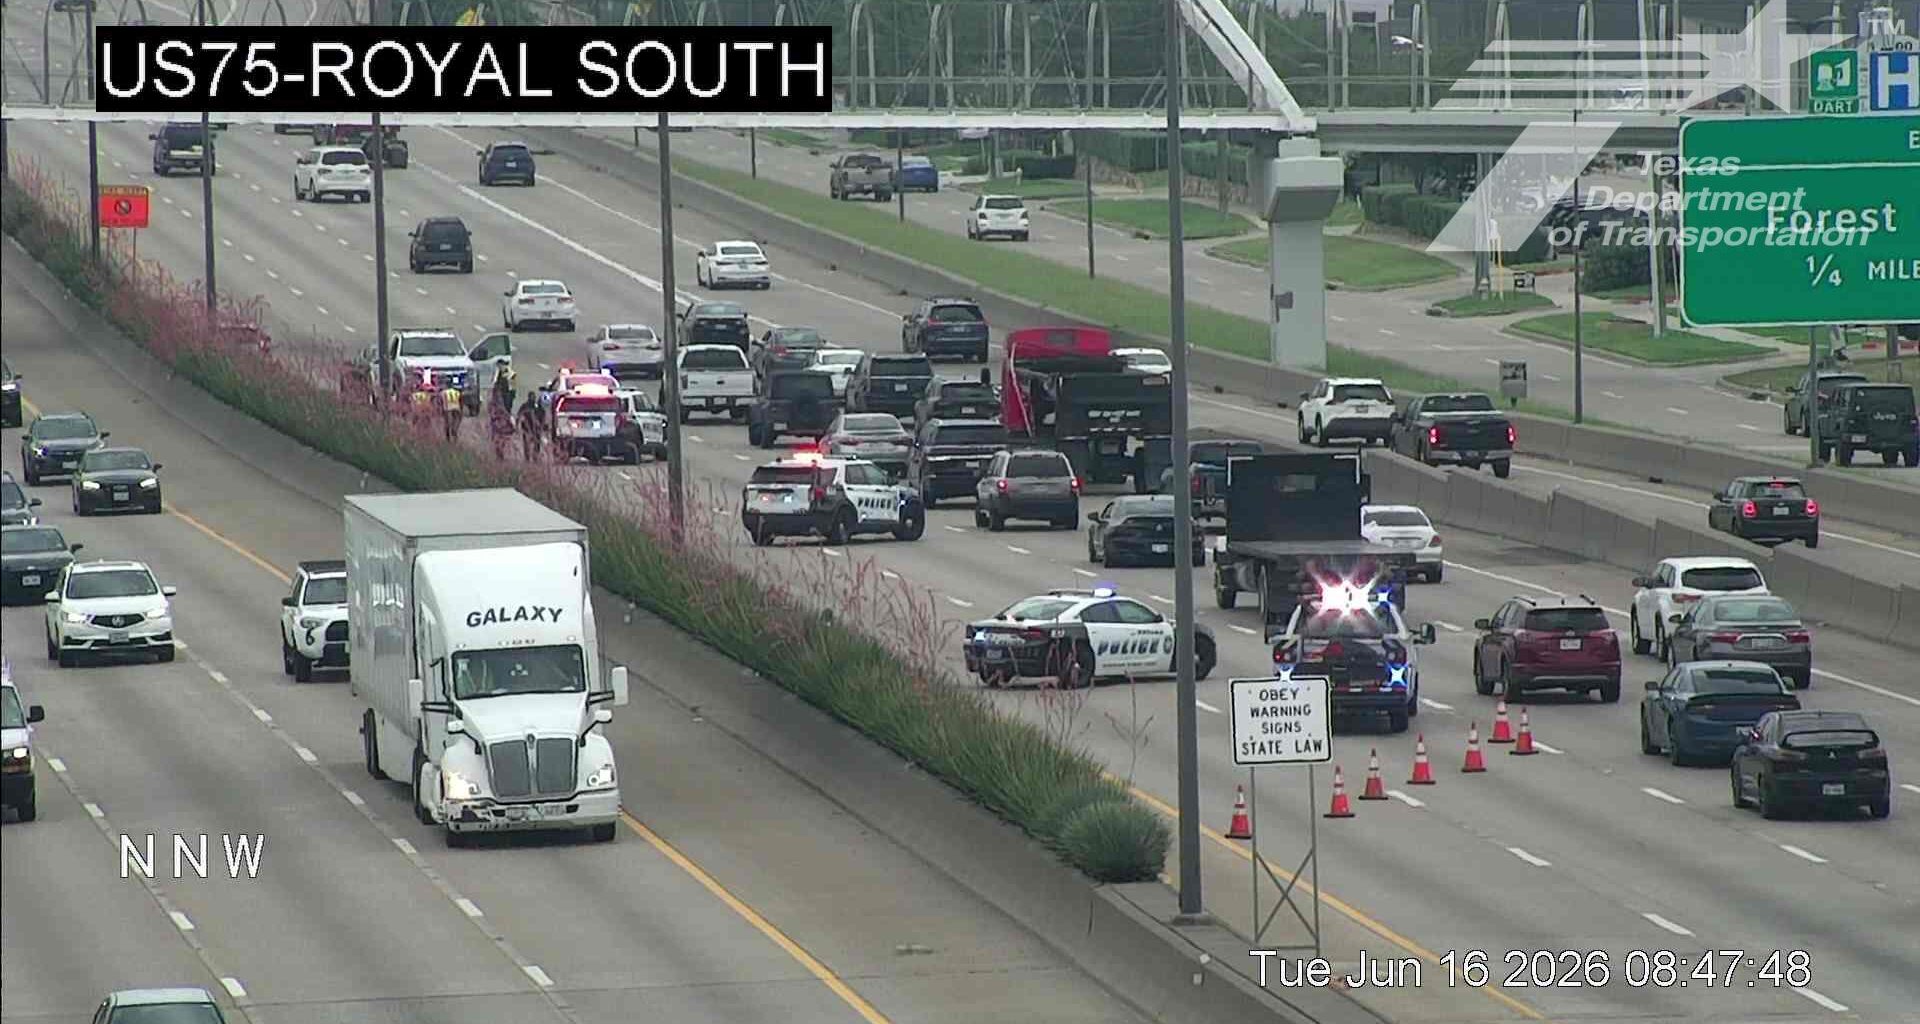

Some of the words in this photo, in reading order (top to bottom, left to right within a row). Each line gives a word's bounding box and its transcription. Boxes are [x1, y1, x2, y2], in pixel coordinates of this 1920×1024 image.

[1877, 55, 1919, 108] H
[1814, 100, 1854, 113] DART
[1767, 203, 1897, 234] Forest
[466, 605, 563, 628] GALAXY
[1096, 638, 1160, 657] POLICE
[1259, 688, 1300, 701] OBEY
[1250, 704, 1312, 718] WARNING
[1261, 721, 1302, 735] SIGNS
[1241, 740, 1283, 756] STATE
[1295, 739, 1323, 753] LAW
